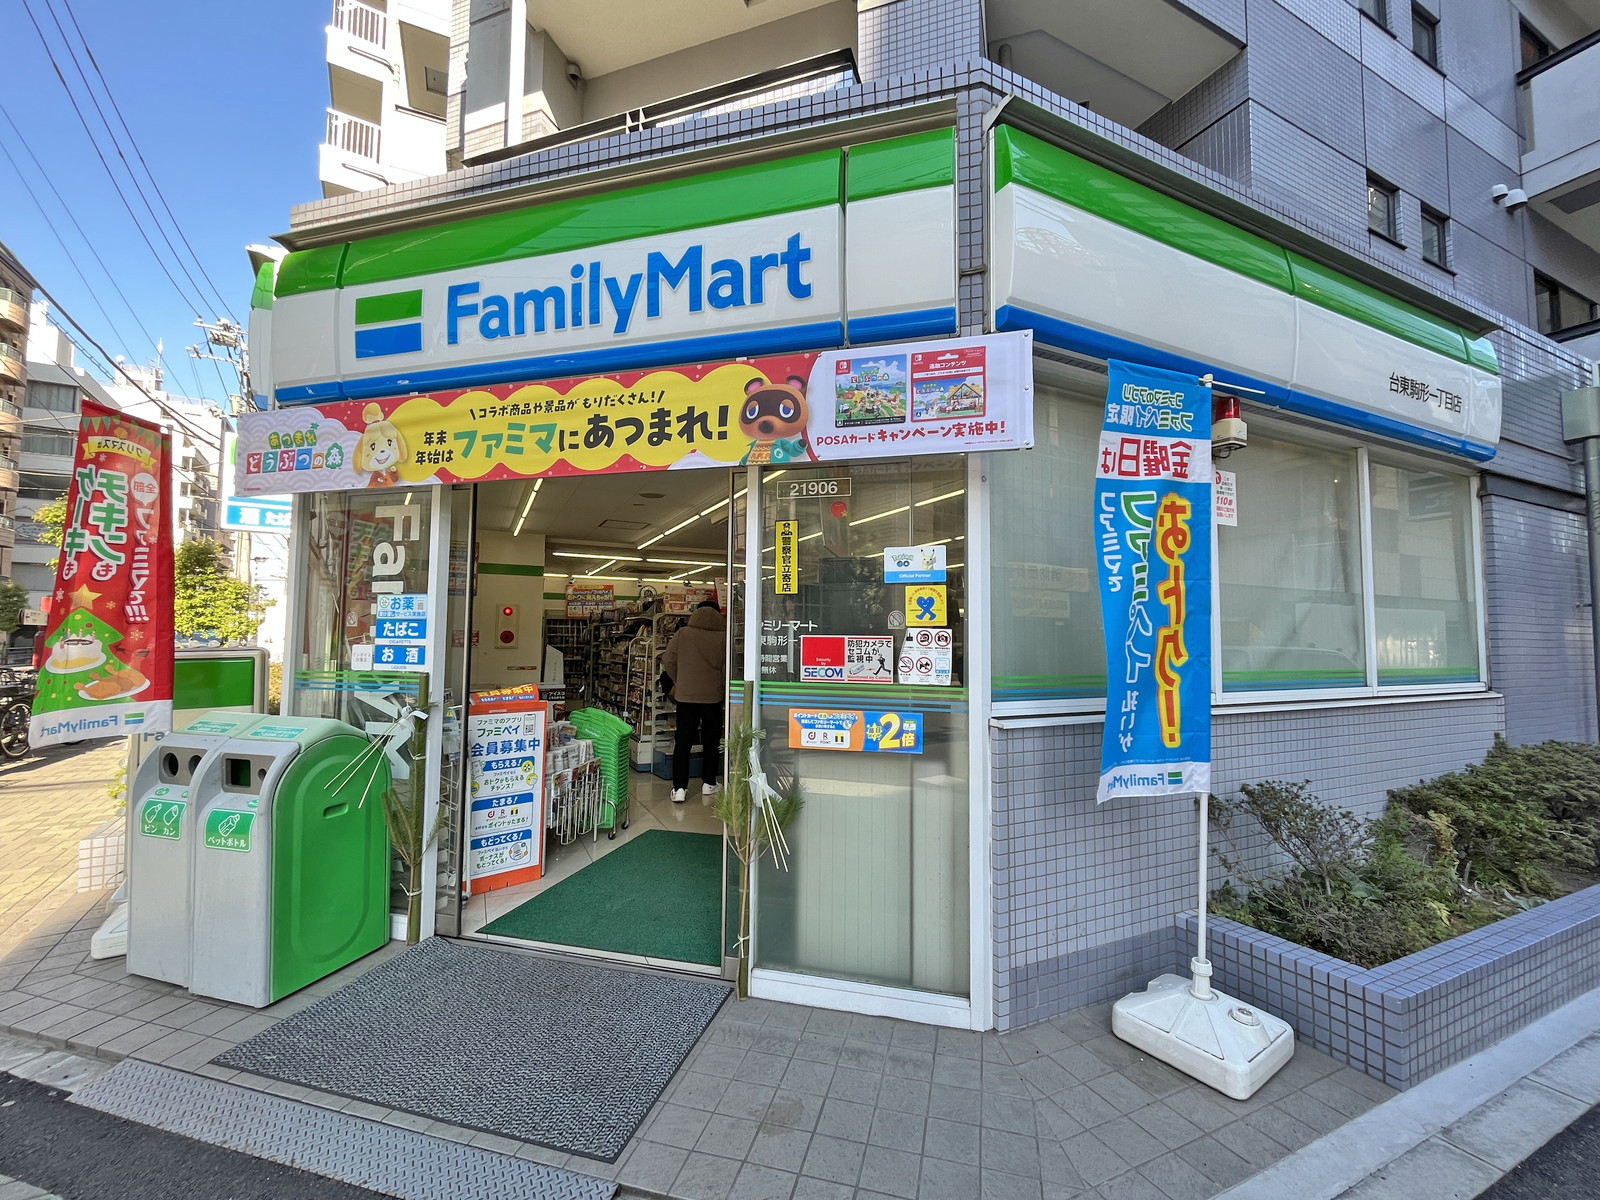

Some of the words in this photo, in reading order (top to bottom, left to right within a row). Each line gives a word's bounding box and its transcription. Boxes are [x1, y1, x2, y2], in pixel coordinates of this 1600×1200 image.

[446, 231, 812, 345] FamilyMart
[1389, 372, 1462, 413] 台東駒形一丁目店
[269, 431, 317, 447] あつまれ
[423, 430, 447, 446] 年末
[816, 421, 1006, 446] POSAカードキャンペーン実施中!
[247, 448, 343, 472] どうぶつの森
[415, 450, 454, 465] 年始は
[789, 481, 838, 496] 21906
[781, 536, 792, 592] 警察官立寄店
[390, 597, 414, 610] お薬
[383, 621, 419, 637] たばこ
[847, 640, 892, 648] 防犯カメラで
[847, 648, 879, 656] セコムが
[847, 655, 873, 663] 監視中
[804, 667, 843, 678] SECOM
[477, 717, 522, 726] ファミマのアプリ
[477, 725, 520, 738] ファミペイ
[471, 738, 540, 758] 会員募集中
[491, 759, 522, 769] もらえる!
[492, 796, 518, 807] たまる!
[144, 824, 157, 834] ビン
[162, 827, 176, 836] カン
[207, 837, 246, 848] ペットボトル
[480, 832, 523, 847] もどってくる!
